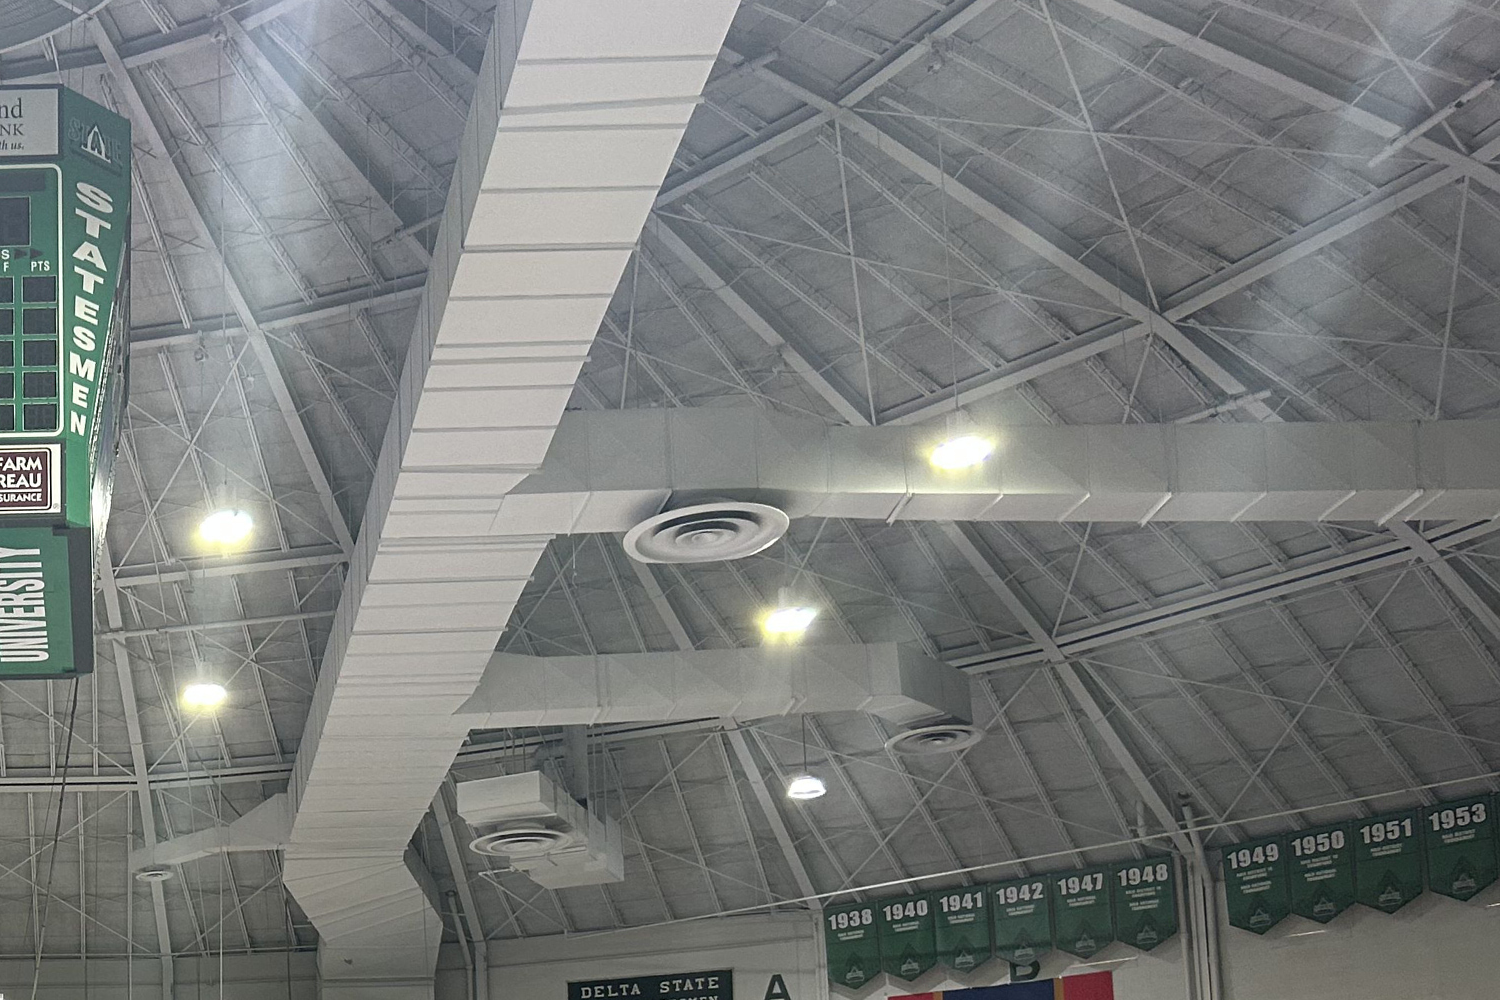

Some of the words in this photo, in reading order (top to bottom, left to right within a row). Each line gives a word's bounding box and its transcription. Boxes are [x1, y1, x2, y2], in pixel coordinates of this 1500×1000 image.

[10, 142, 24, 150] us.
[4, 262, 9, 272] F
[31, 261, 50, 272] PTS
[69, 181, 113, 436] STATESMEN
[1428, 803, 1487, 831] 1953
[1360, 818, 1413, 844] 1951
[1291, 830, 1345, 856] 1950
[1227, 843, 1279, 869] 1949
[1058, 873, 1103, 895] 1947
[1118, 864, 1169, 886] 1948
[940, 891, 983, 912] 1941
[996, 882, 1044, 904] 1942
[828, 909, 873, 930] 1938
[883, 900, 928, 921] 1940
[581, 984, 641, 999] DELTA
[660, 976, 720, 994] STATE
